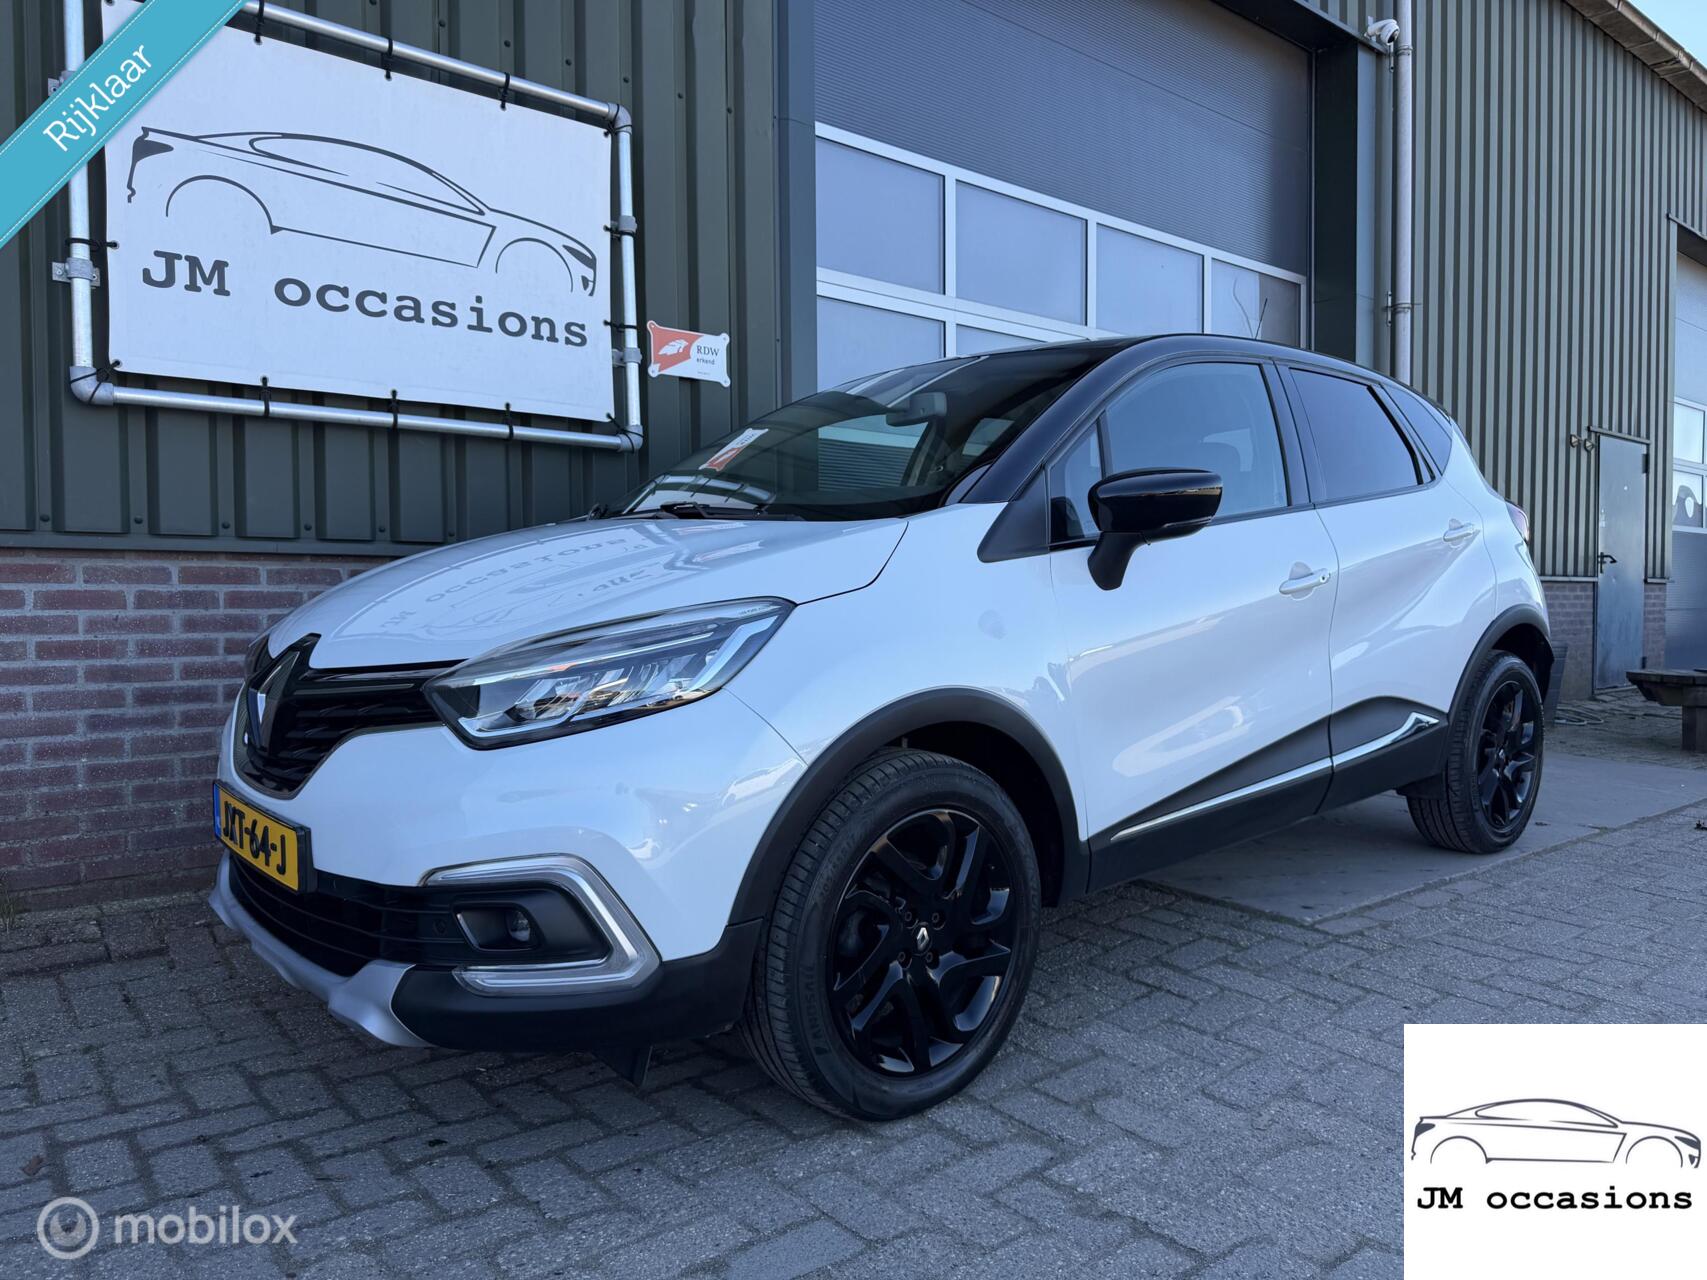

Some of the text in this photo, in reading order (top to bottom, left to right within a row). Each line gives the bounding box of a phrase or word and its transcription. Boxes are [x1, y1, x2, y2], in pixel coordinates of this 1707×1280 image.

[142, 250, 588, 348] JM occasions
[696, 345, 720, 357] RDW
